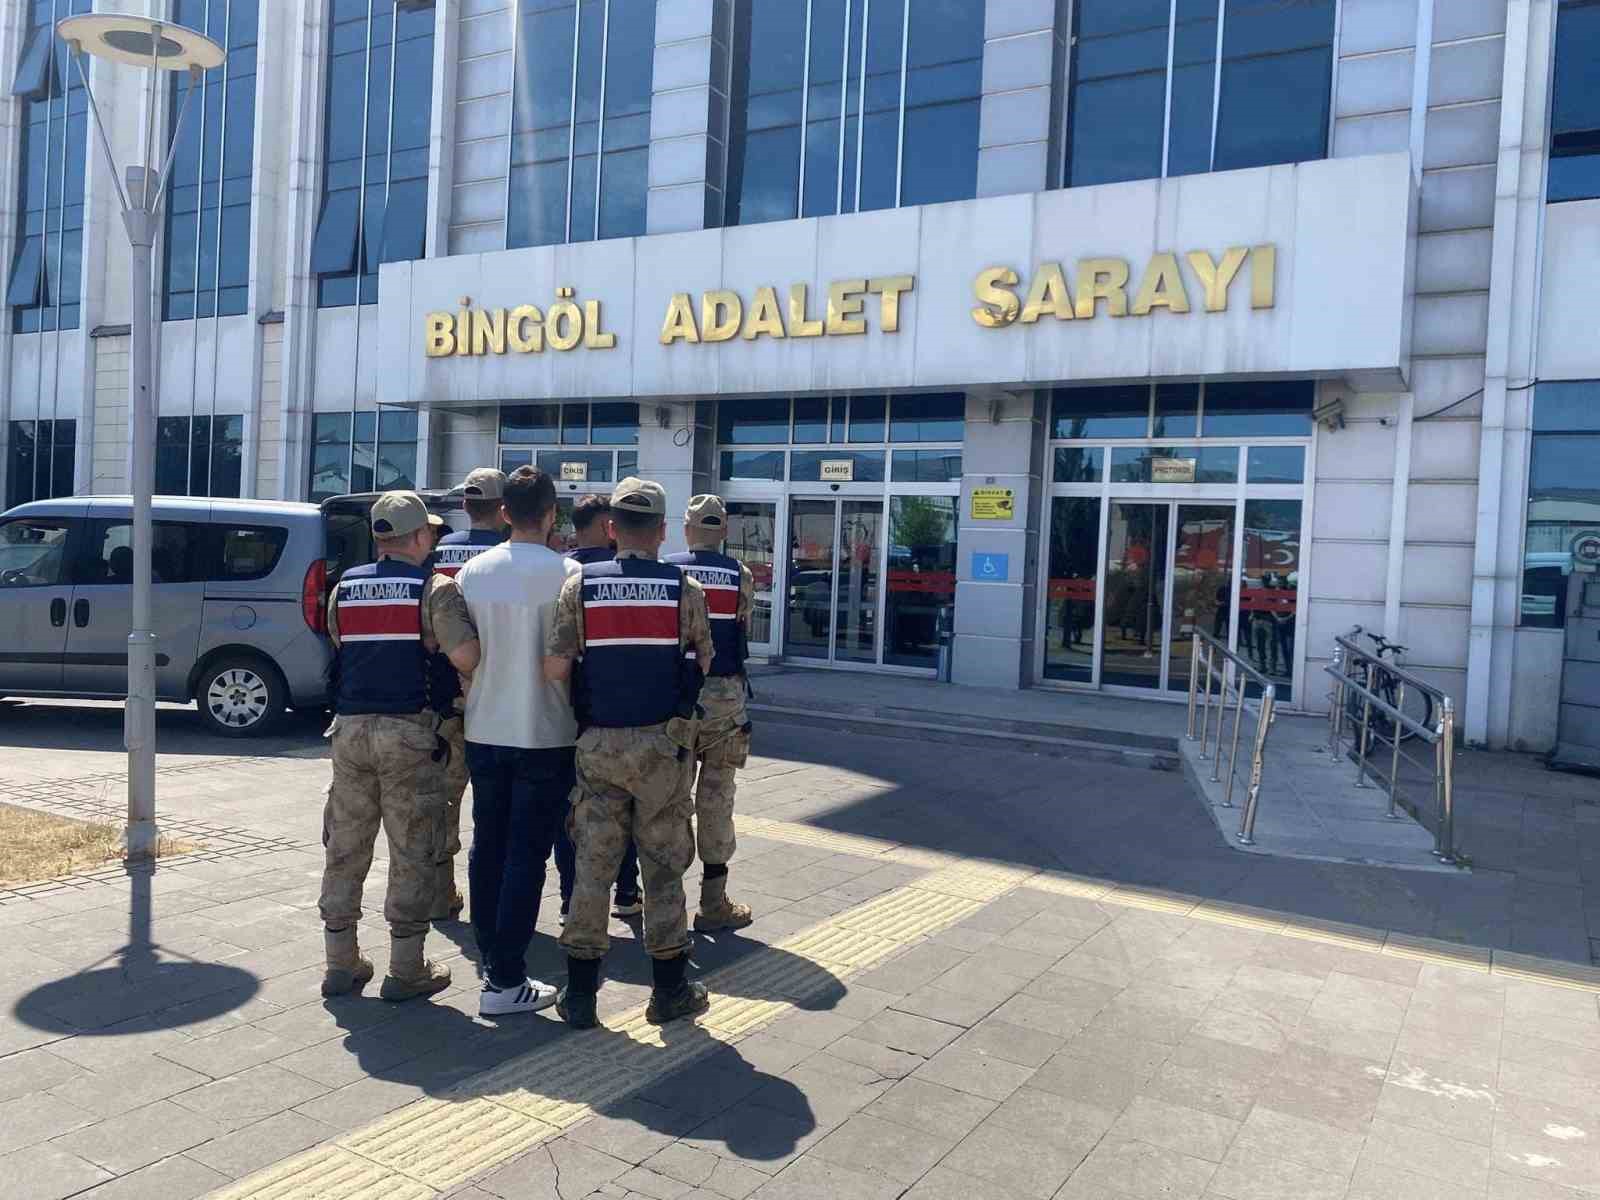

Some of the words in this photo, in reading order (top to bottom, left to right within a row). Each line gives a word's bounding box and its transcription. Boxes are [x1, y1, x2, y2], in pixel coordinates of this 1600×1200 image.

[425, 287, 615, 357] BİNGÖL
[660, 275, 915, 345] ADALET
[971, 244, 1276, 328] SARAYI
[440, 550, 485, 562] JANDAR
[346, 583, 411, 600] JANDARMA
[593, 583, 669, 601] JANDARMA
